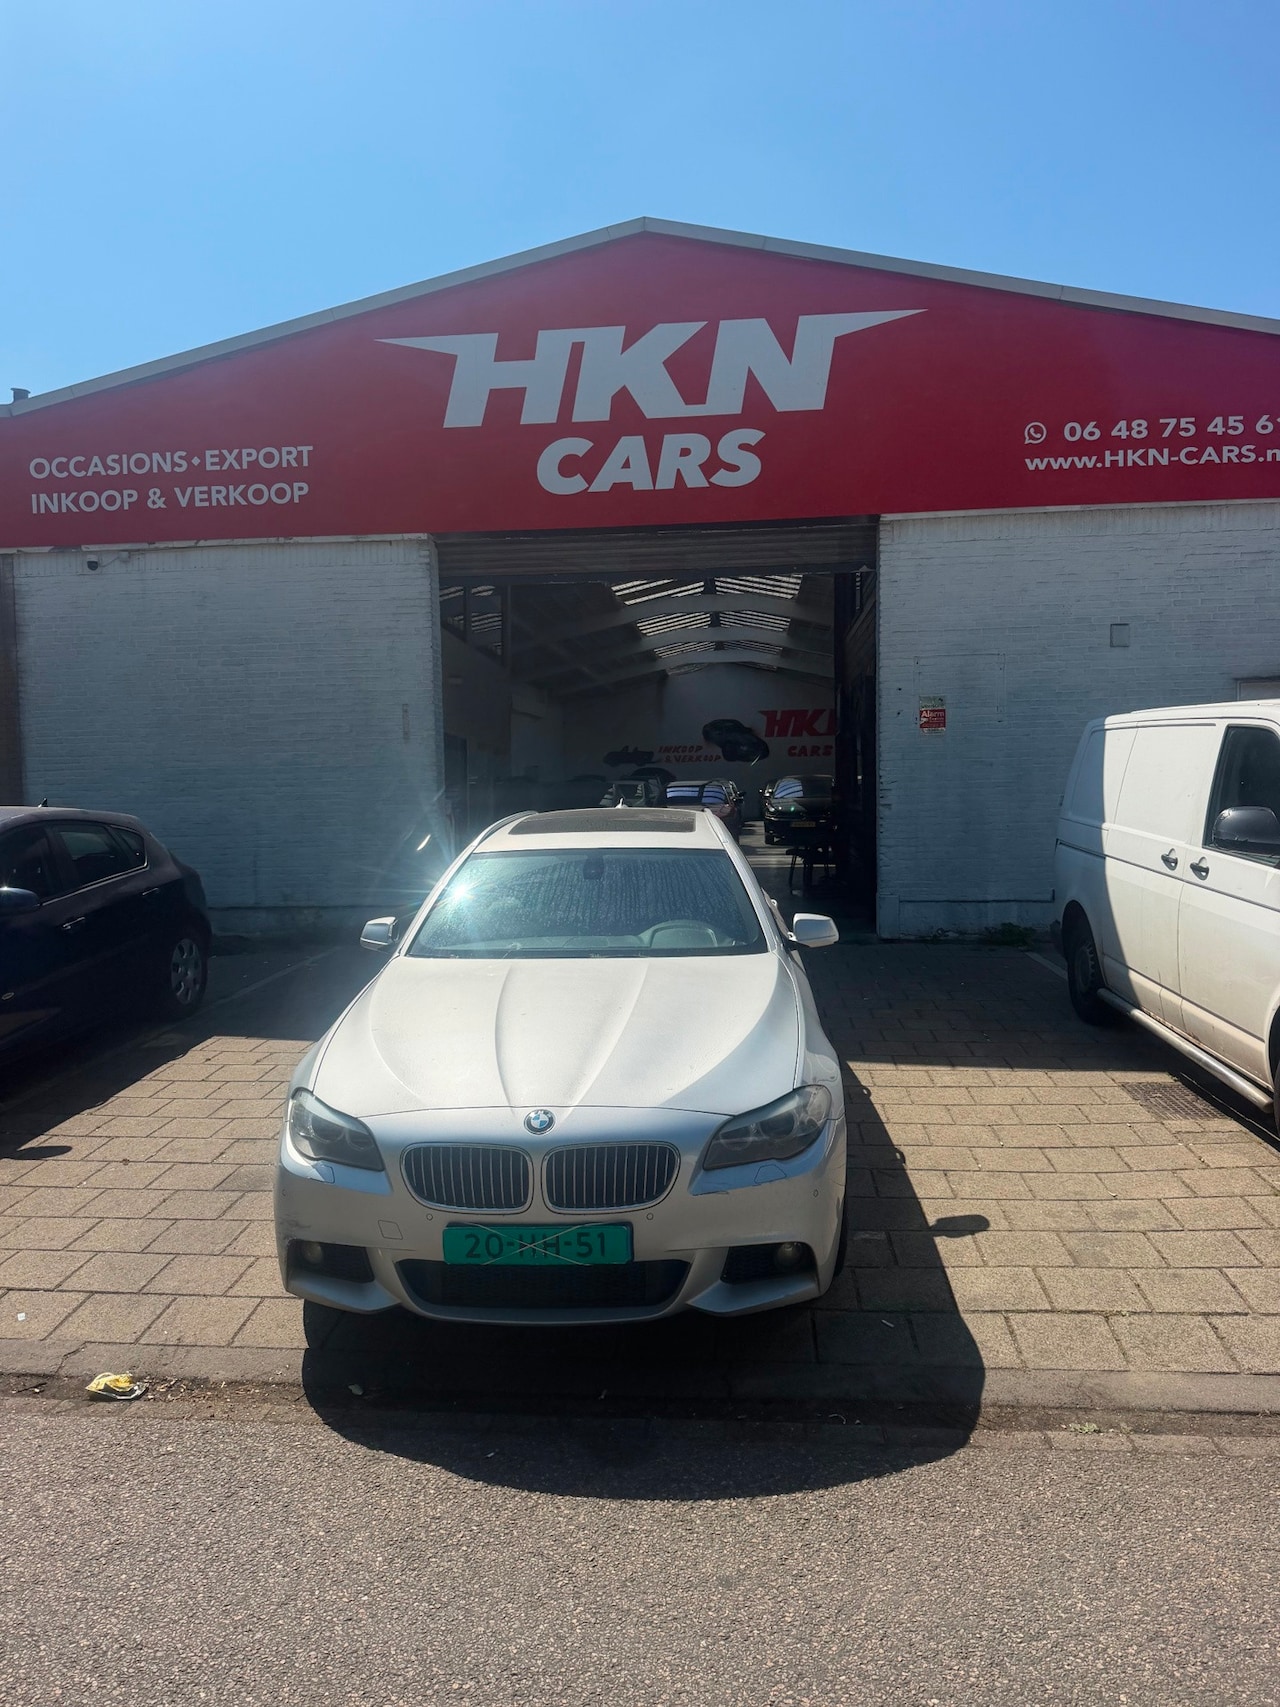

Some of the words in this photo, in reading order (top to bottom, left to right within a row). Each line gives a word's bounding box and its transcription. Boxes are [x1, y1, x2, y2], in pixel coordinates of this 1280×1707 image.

[374, 308, 929, 429] HKN
[1063, 421, 1101, 442] 06
[1111, 419, 1149, 439] 48
[1159, 417, 1196, 438] 75
[1207, 415, 1245, 436] 45
[1255, 414, 1280, 435] 6
[536, 428, 766, 495] CARS
[31, 489, 138, 514] INKOOP
[146, 487, 167, 509] &
[174, 482, 309, 508] VERKOOP
[921, 710, 944, 718] Alarm
[658, 745, 703, 753] INKOOP
[787, 745, 834, 757] CARS
